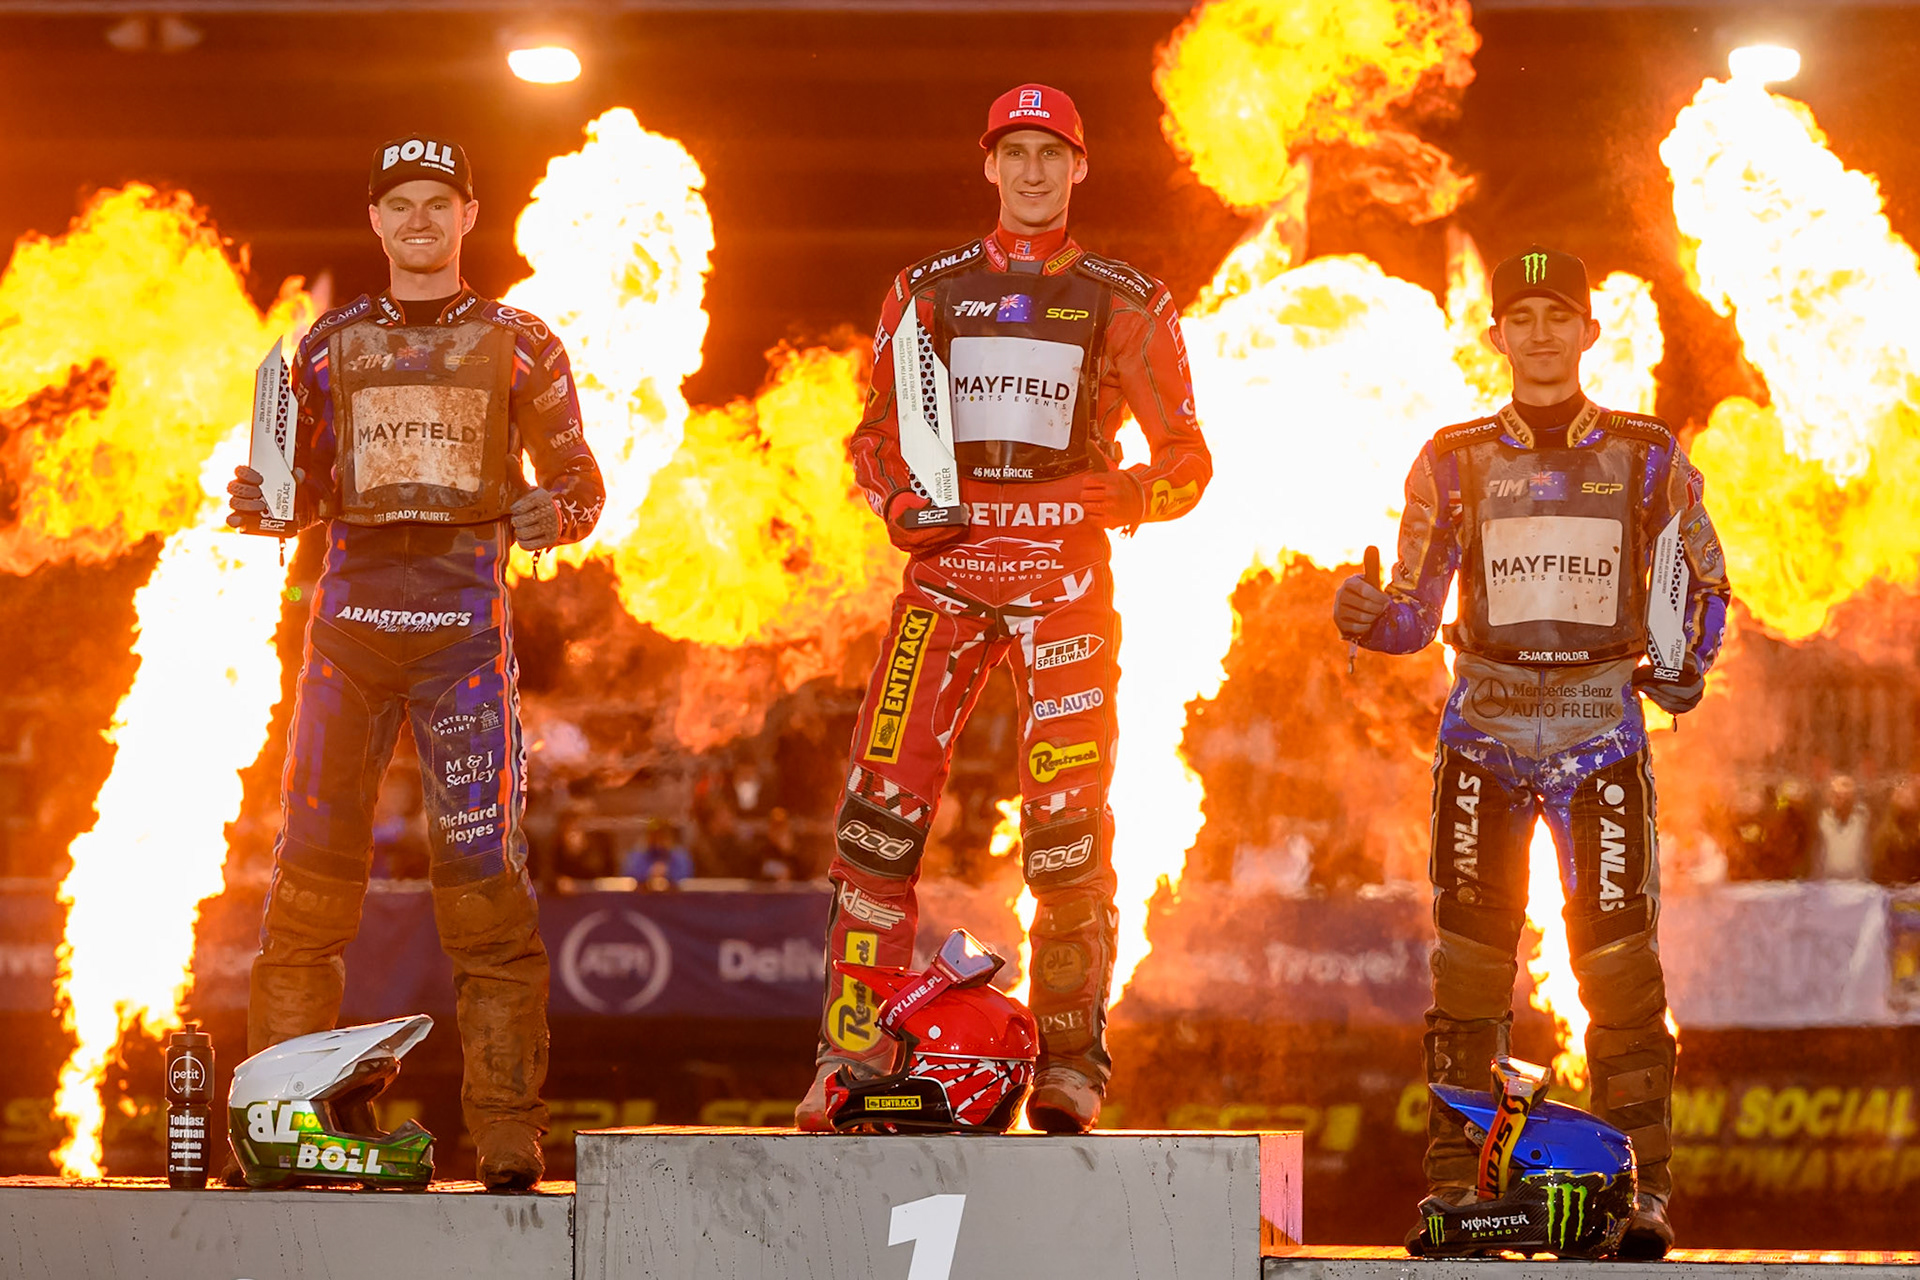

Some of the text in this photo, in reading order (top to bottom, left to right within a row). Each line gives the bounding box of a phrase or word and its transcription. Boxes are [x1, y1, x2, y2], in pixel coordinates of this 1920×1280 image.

[1009, 109, 1050, 119] BETARD
[382, 139, 456, 170] BOLL
[929, 243, 980, 273] ANLAS
[1083, 260, 1147, 298] KUBIAKPOL
[952, 300, 997, 317] FIM
[1045, 308, 1089, 320] SGP
[955, 376, 1070, 401] MAYFIELD
[955, 395, 1067, 410] SPORTS EVENTS
[359, 421, 478, 445] MAYFIELD
[973, 467, 1034, 478] 46 MAX FRICKE
[282, 482, 291, 505] PLACE
[942, 467, 952, 502] WINNER
[1488, 480, 1526, 497] FIM
[1581, 482, 1624, 494] SGP
[260, 519, 286, 529] SGP
[386, 510, 418, 522] BRADY
[420, 511, 450, 521] KURTZ
[918, 509, 948, 520] SGP
[940, 556, 1064, 573] KUBIAKPOL
[1491, 554, 1612, 578] MAYFIELD
[952, 572, 982, 580] AUTO
[1493, 574, 1611, 586] SPORTS EVENTS
[336, 606, 472, 627] ARMSTRONG'S
[884, 613, 929, 712] ENTRACK
[1037, 649, 1087, 669] SPEEDWAY
[1530, 651, 1553, 661] JACK
[1555, 651, 1589, 661] HOLDER
[1654, 668, 1680, 678] SGP
[1512, 683, 1613, 698] Mercedes-Benz
[1035, 690, 1102, 718] G.B. AUTO
[1512, 703, 1616, 718] AUTO FRELIK
[432, 715, 477, 733] EASTERN
[440, 724, 471, 735] POINT
[445, 750, 494, 774] M & J
[1032, 750, 1096, 775] Rentrack
[446, 768, 496, 788] Sealey
[439, 803, 497, 830] Richard
[1454, 771, 1481, 879] ANLAS
[446, 822, 495, 844] Hayes
[838, 820, 914, 860] pod
[1029, 834, 1094, 878] pod
[1601, 816, 1626, 912] ANLAS
[837, 939, 871, 1041] Rentck
[173, 1068, 199, 1084] petit
[881, 1098, 918, 1107] ENTRACK
[170, 1114, 204, 1126] Tobiasz
[1736, 1086, 1916, 1139] SOCIAL
[169, 1127, 205, 1139] Herman
[171, 1151, 201, 1160] sportowe
[297, 1144, 384, 1174] BOLL
[1461, 1212, 1530, 1231] MONSTER
[888, 1194, 966, 1280] 1
[1472, 1228, 1520, 1238] ENERGY
